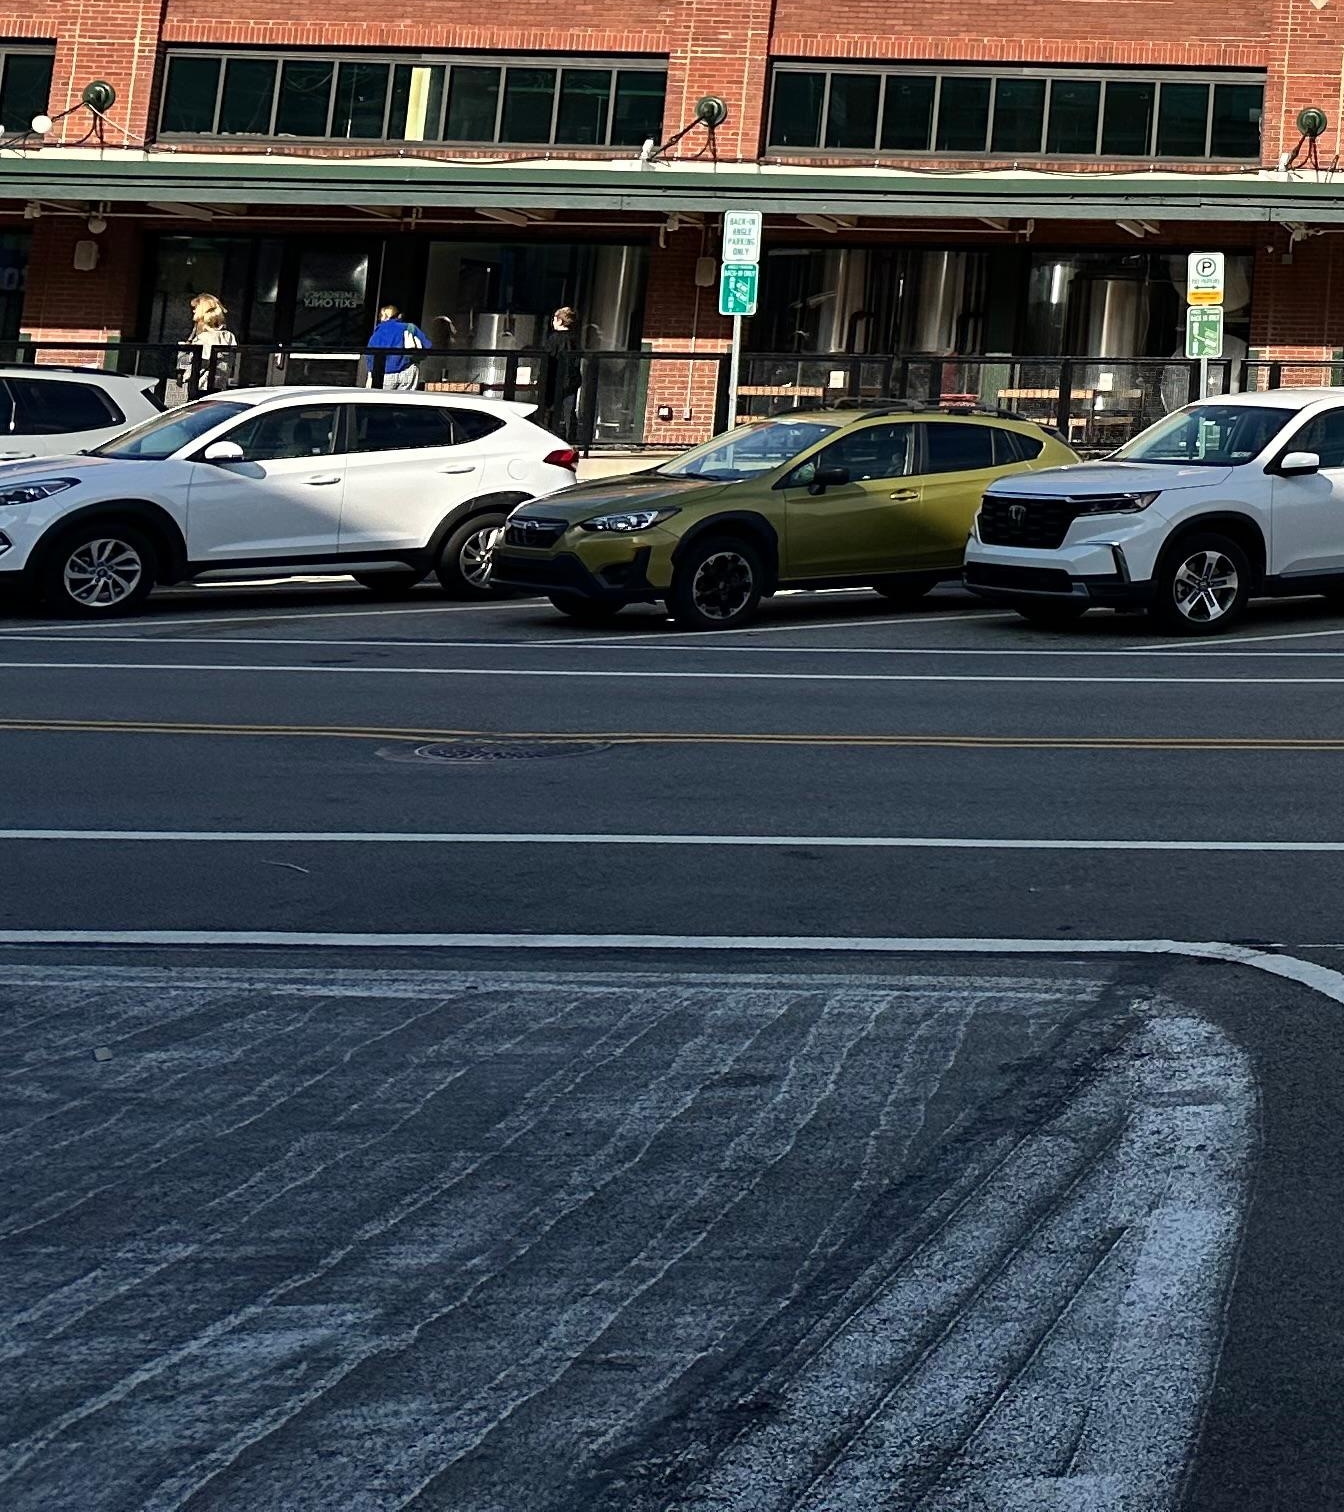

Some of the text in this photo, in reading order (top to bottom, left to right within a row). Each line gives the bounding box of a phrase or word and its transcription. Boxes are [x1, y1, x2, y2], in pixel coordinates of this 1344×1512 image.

[728, 238, 756, 246] PARKING
[733, 248, 750, 256] ONLY
[1202, 261, 1212, 273] P
